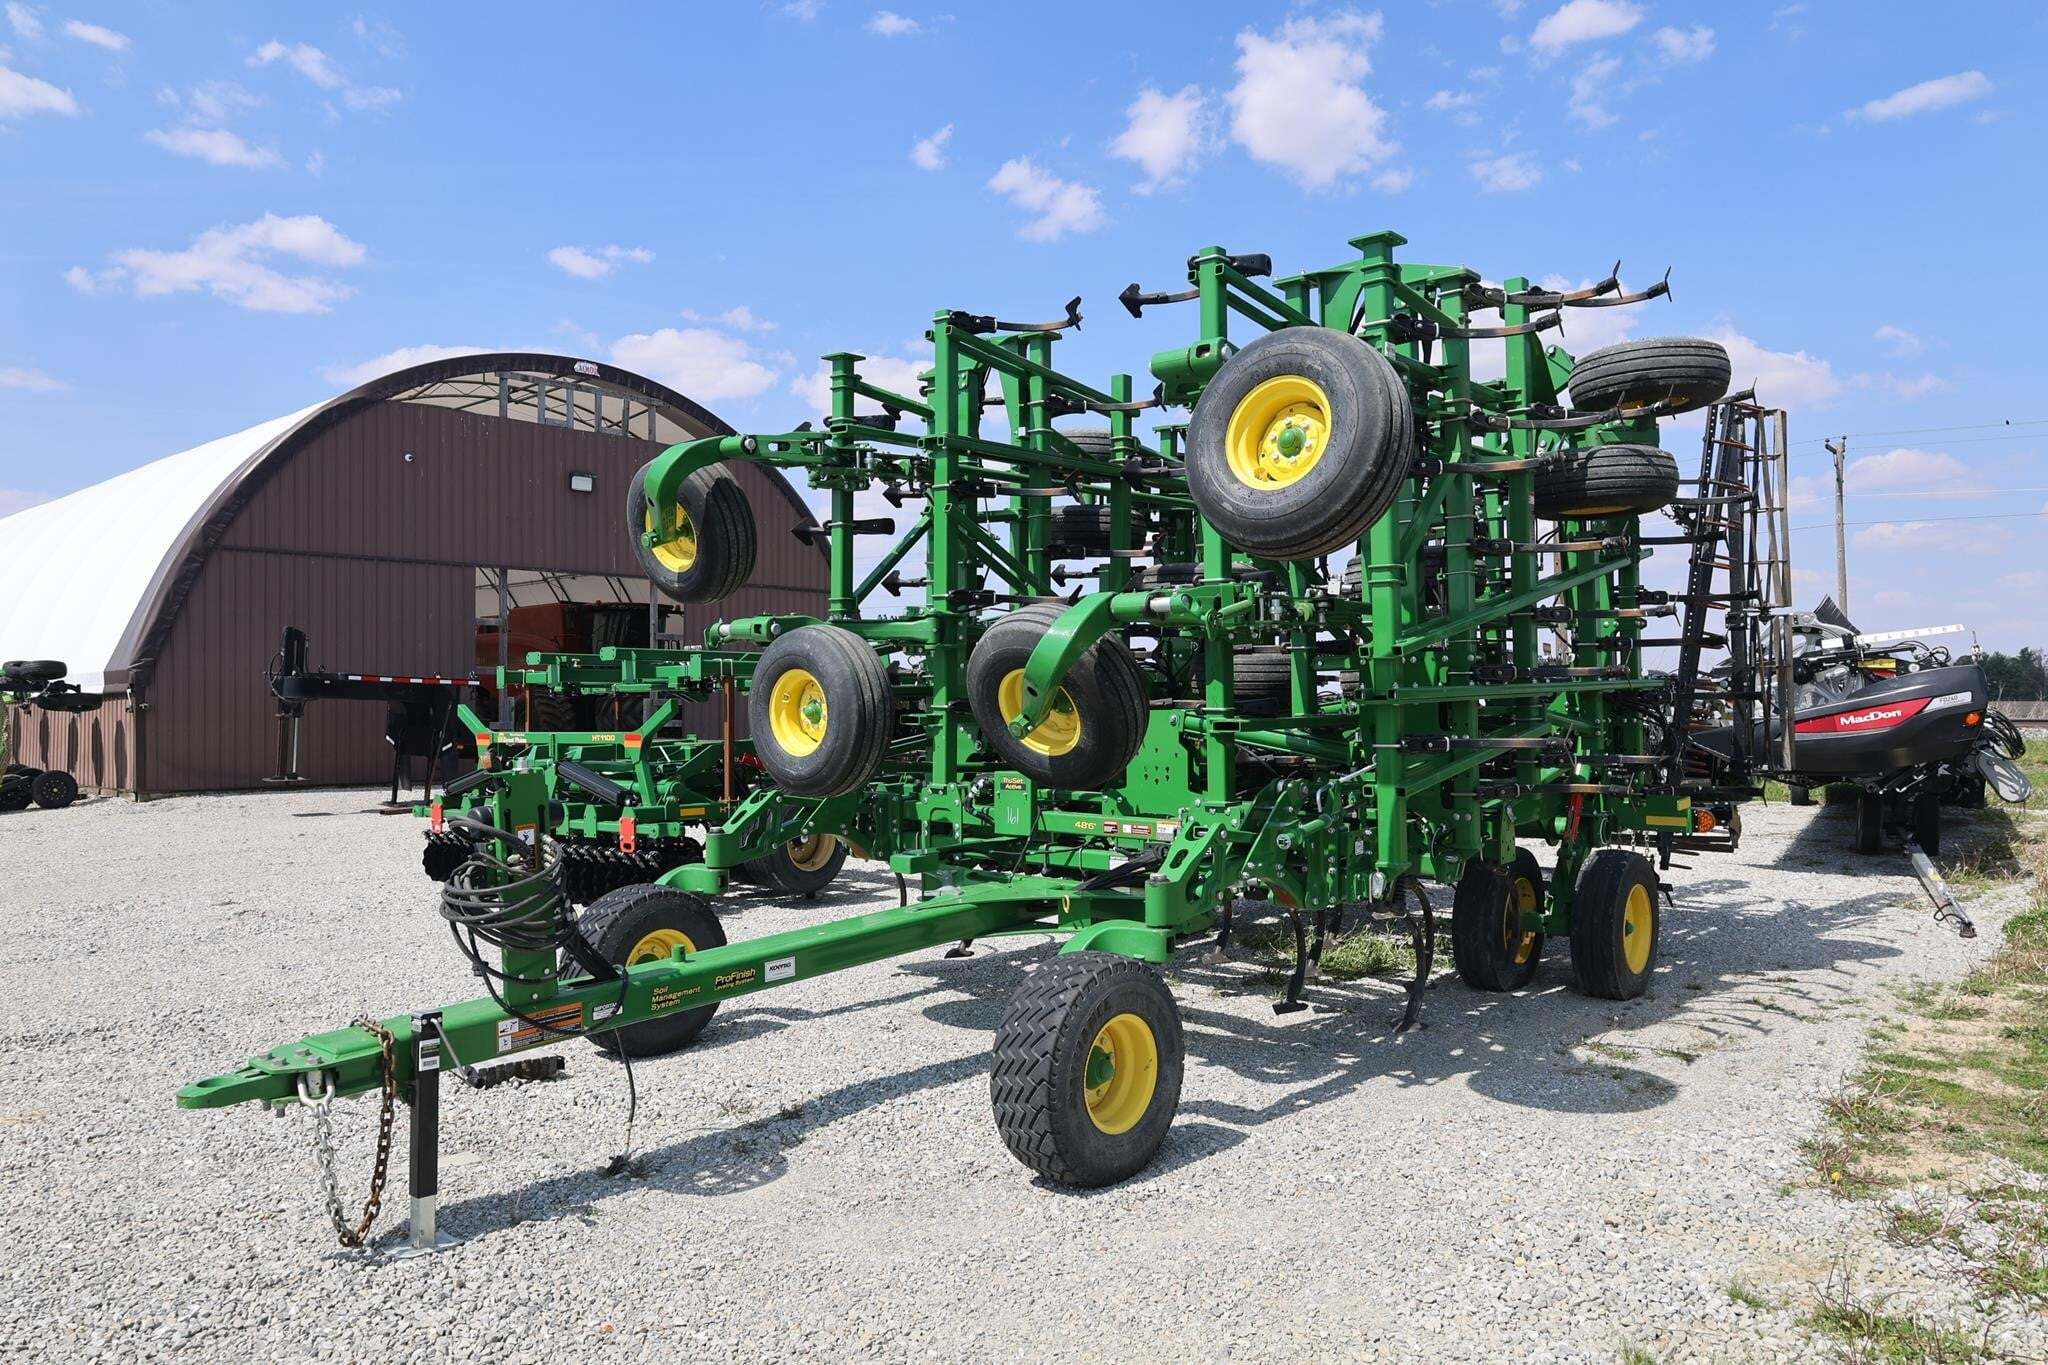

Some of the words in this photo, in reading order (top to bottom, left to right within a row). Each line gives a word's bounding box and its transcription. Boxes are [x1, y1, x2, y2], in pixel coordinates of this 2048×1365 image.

[1839, 710, 1902, 725] MacDon
[715, 968, 756, 985] ProFinish
[651, 986, 701, 1003] Management
[653, 985, 669, 996] Soil
[650, 999, 681, 1011] System
